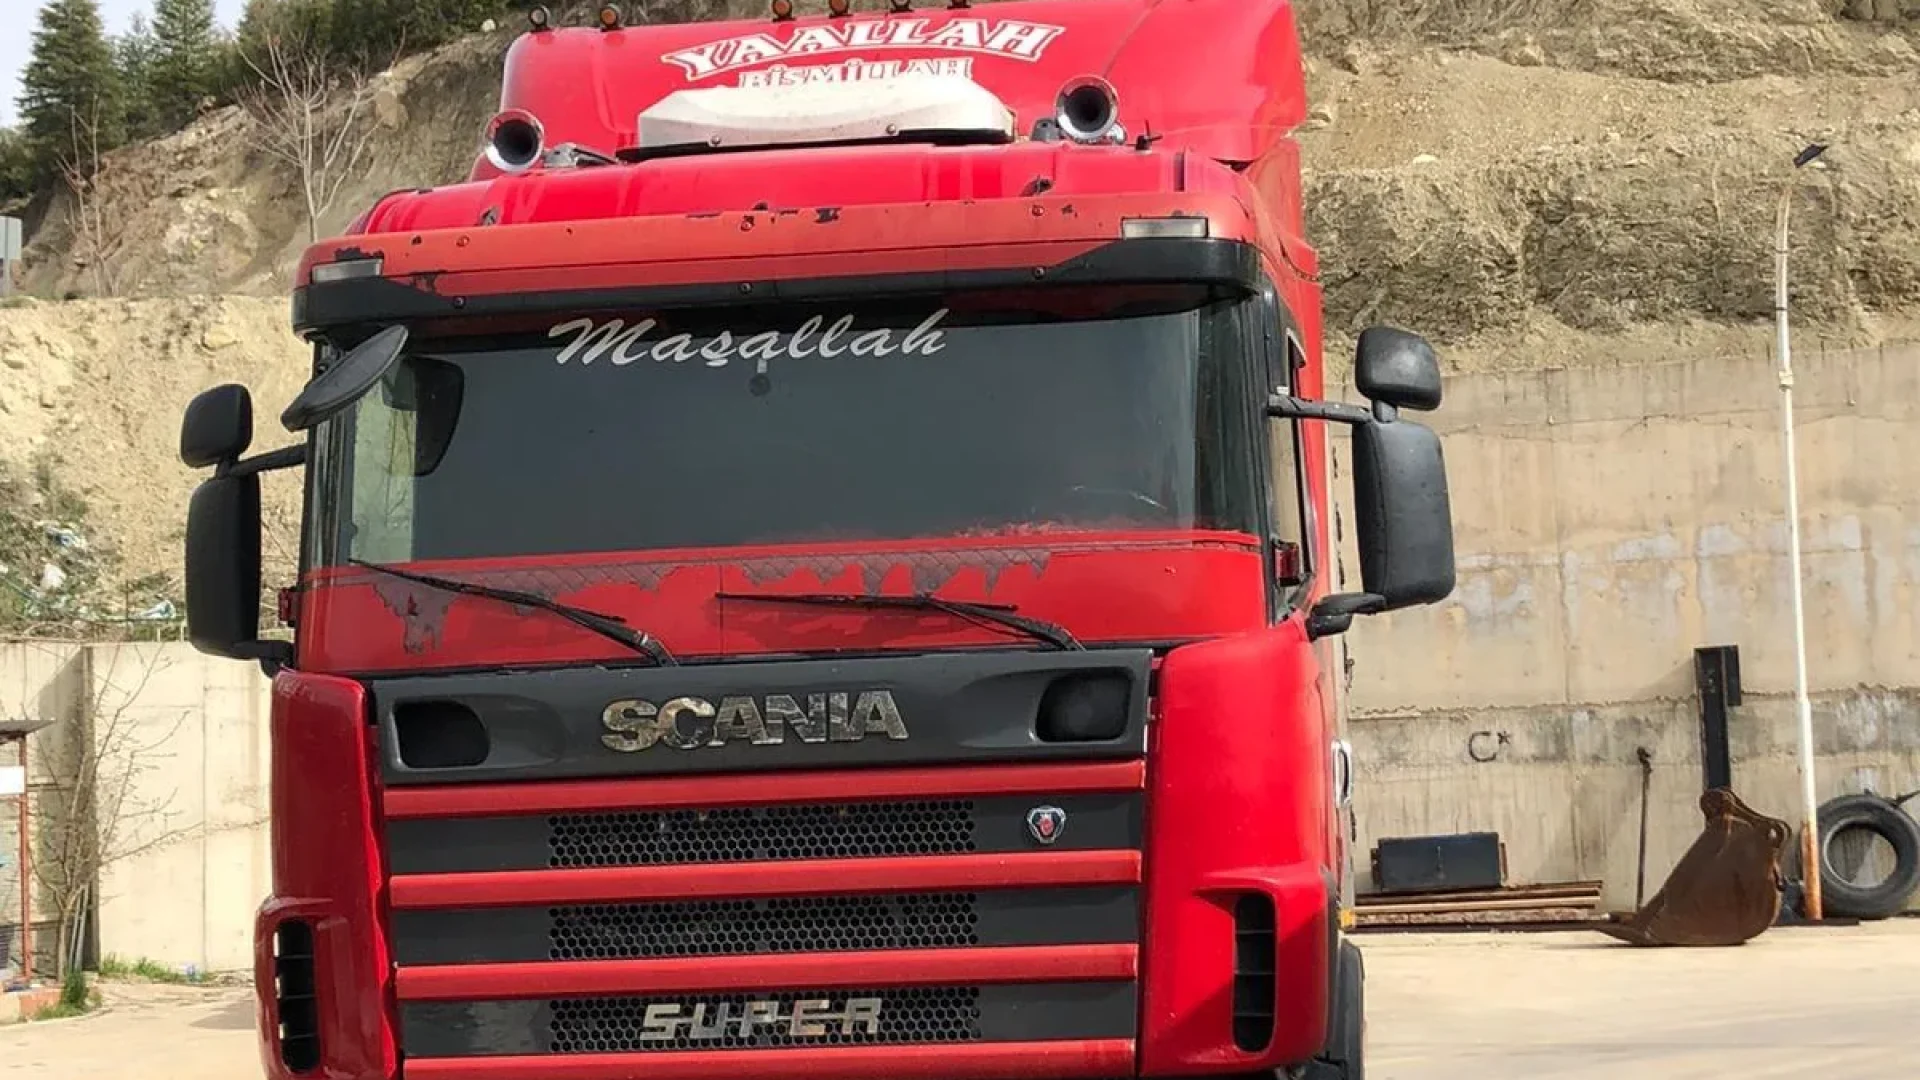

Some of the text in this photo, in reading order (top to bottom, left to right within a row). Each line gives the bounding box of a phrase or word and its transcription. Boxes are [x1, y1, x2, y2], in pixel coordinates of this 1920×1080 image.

[549, 309, 949, 367] Maşallah
[601, 690, 909, 752] SCANIA
[640, 998, 882, 1041] SUPER
